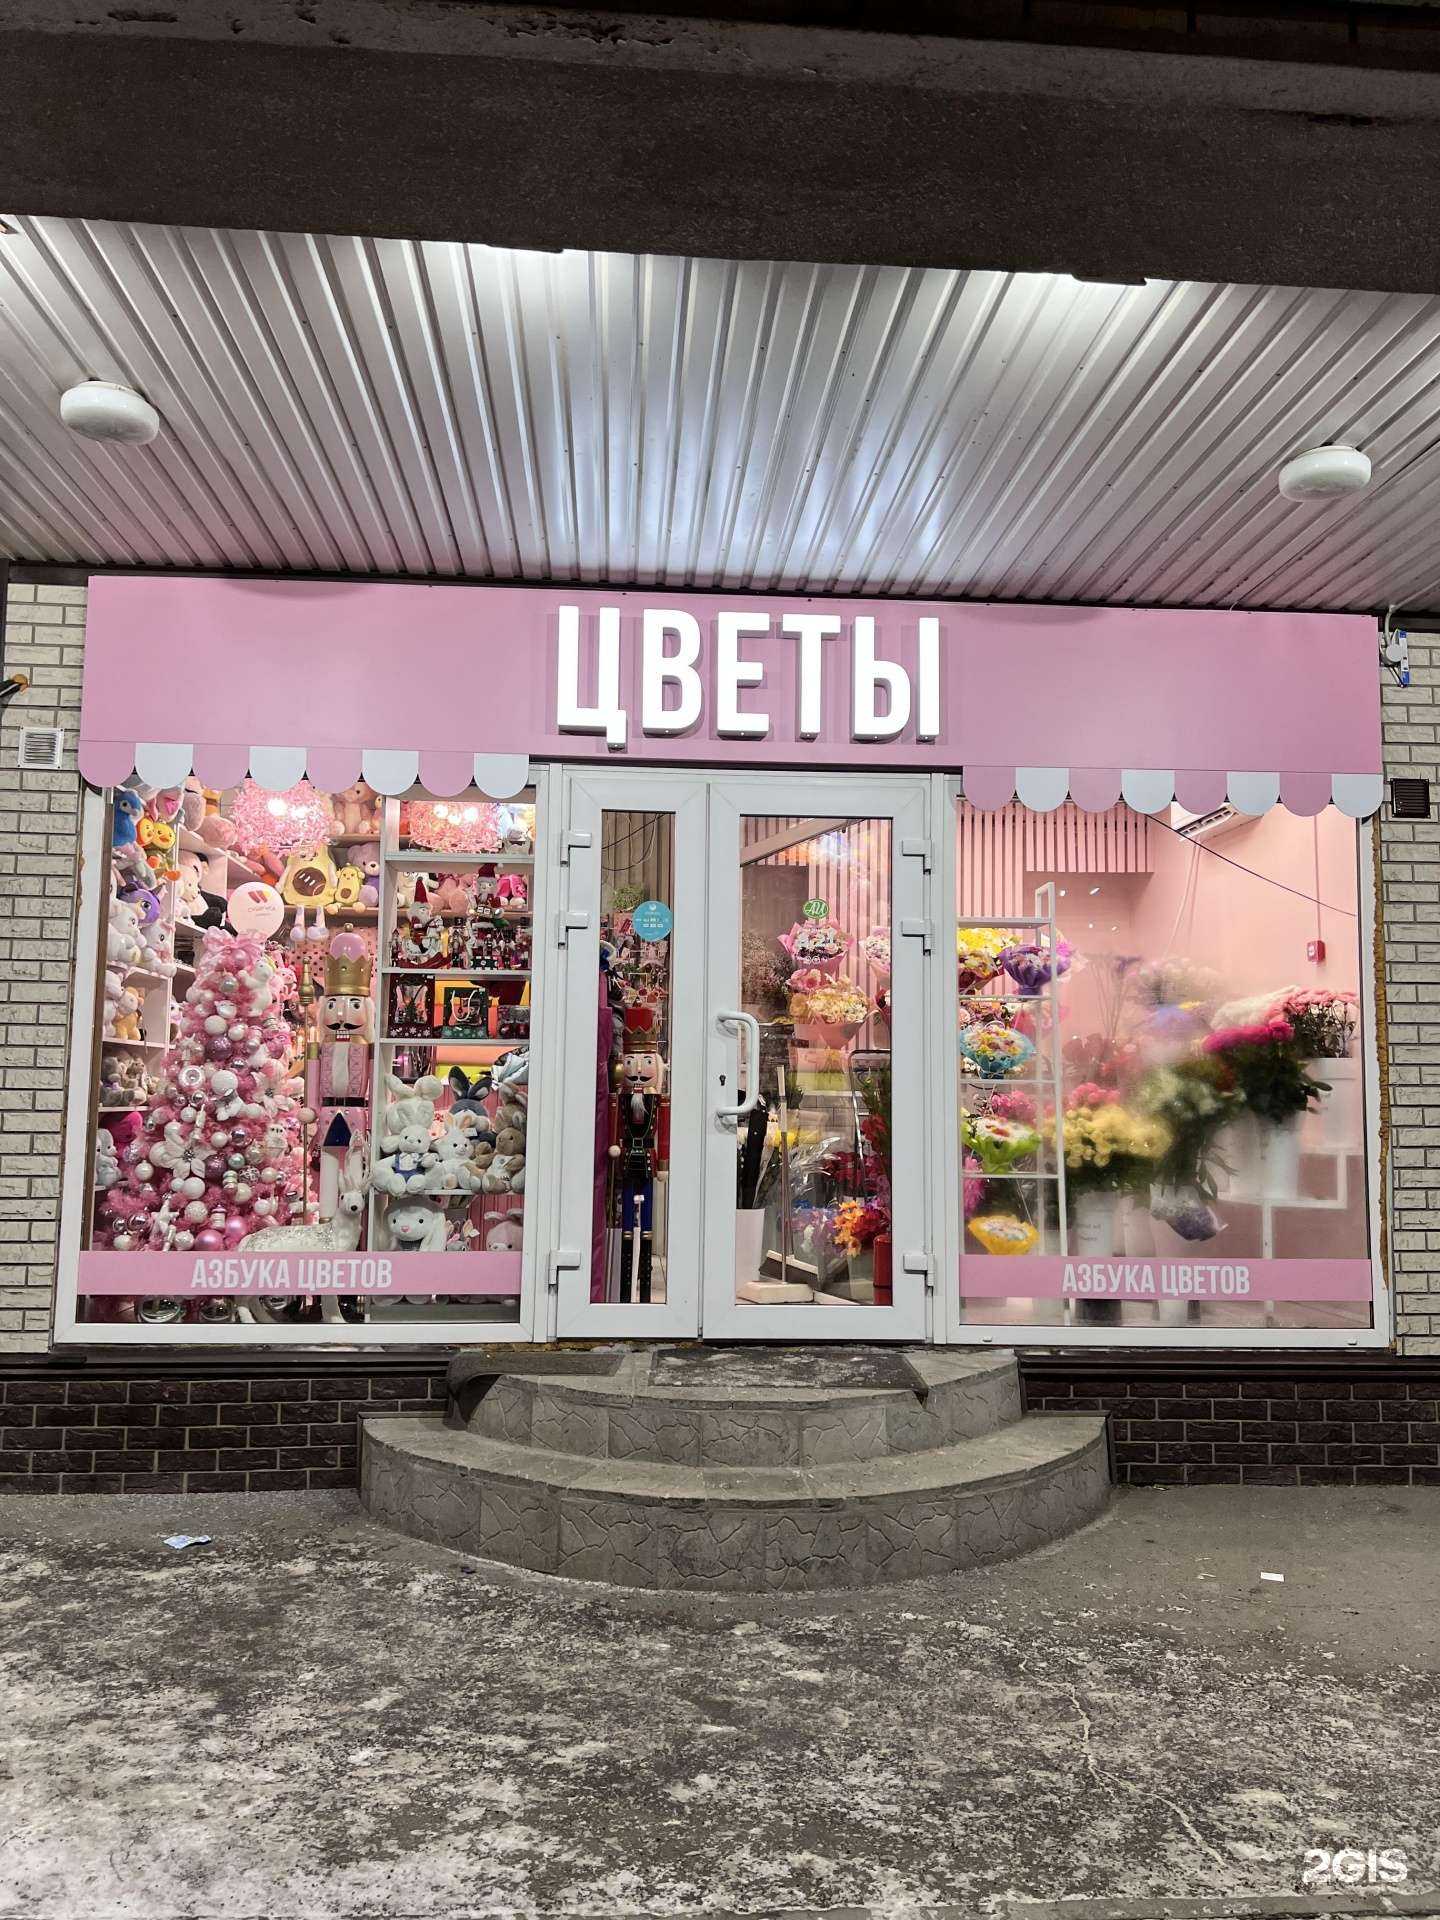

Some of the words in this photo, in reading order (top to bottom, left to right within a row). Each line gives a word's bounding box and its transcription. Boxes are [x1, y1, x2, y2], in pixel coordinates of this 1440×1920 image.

[557, 605, 940, 751] ЦВЕТЫ
[191, 1258, 290, 1289] АЗБУКА
[298, 1258, 393, 1291] ЦВЕТОВ
[1062, 1263, 1155, 1293] АЗБУКА
[1161, 1265, 1250, 1296] ЦВЕТОВ
